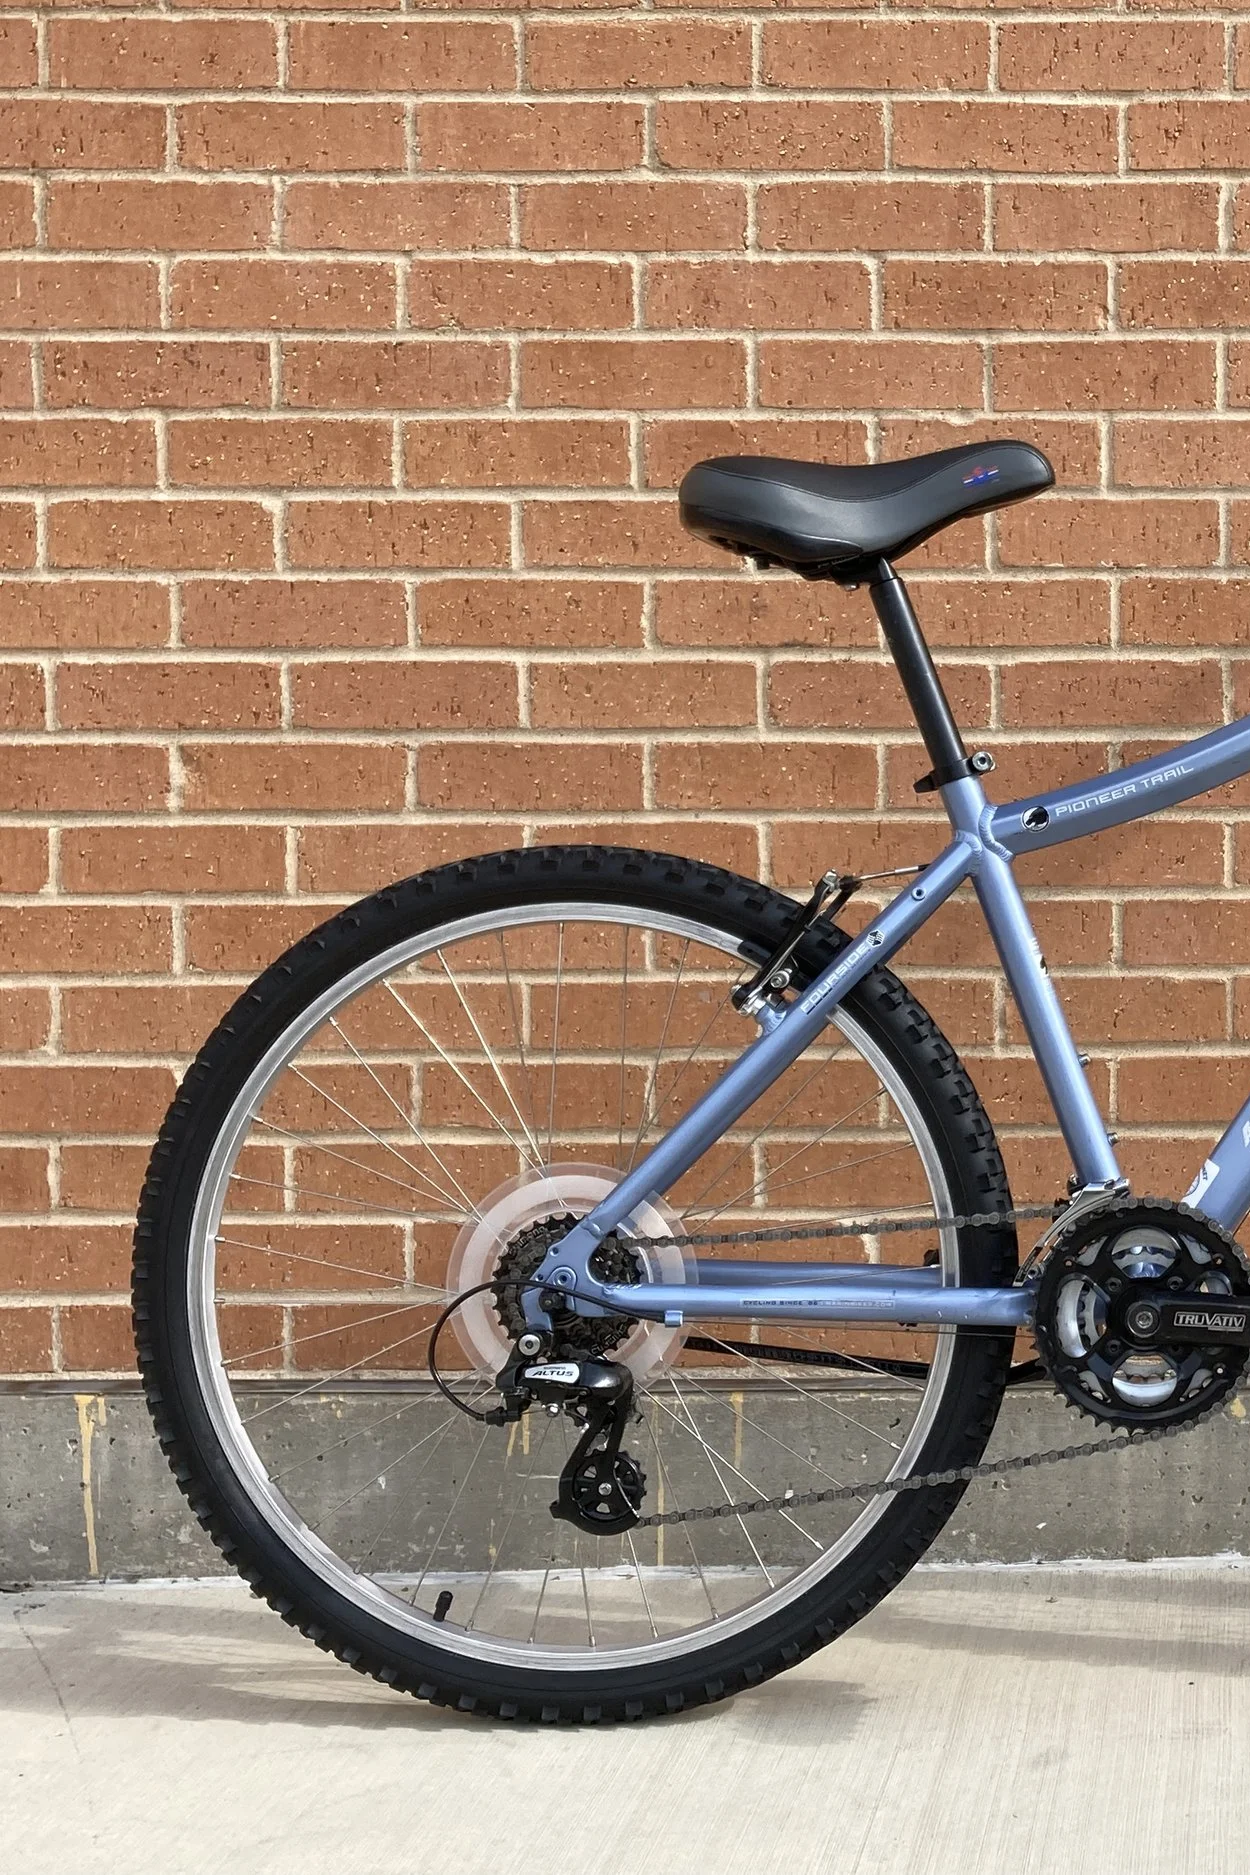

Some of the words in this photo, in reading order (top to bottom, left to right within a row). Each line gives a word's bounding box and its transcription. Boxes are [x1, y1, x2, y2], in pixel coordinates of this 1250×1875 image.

[1055, 783, 1136, 817] PIONEER
[1140, 765, 1194, 789] TRAIL
[800, 942, 870, 1013] FOURSIDE
[532, 1369, 574, 1377] ALTUS
